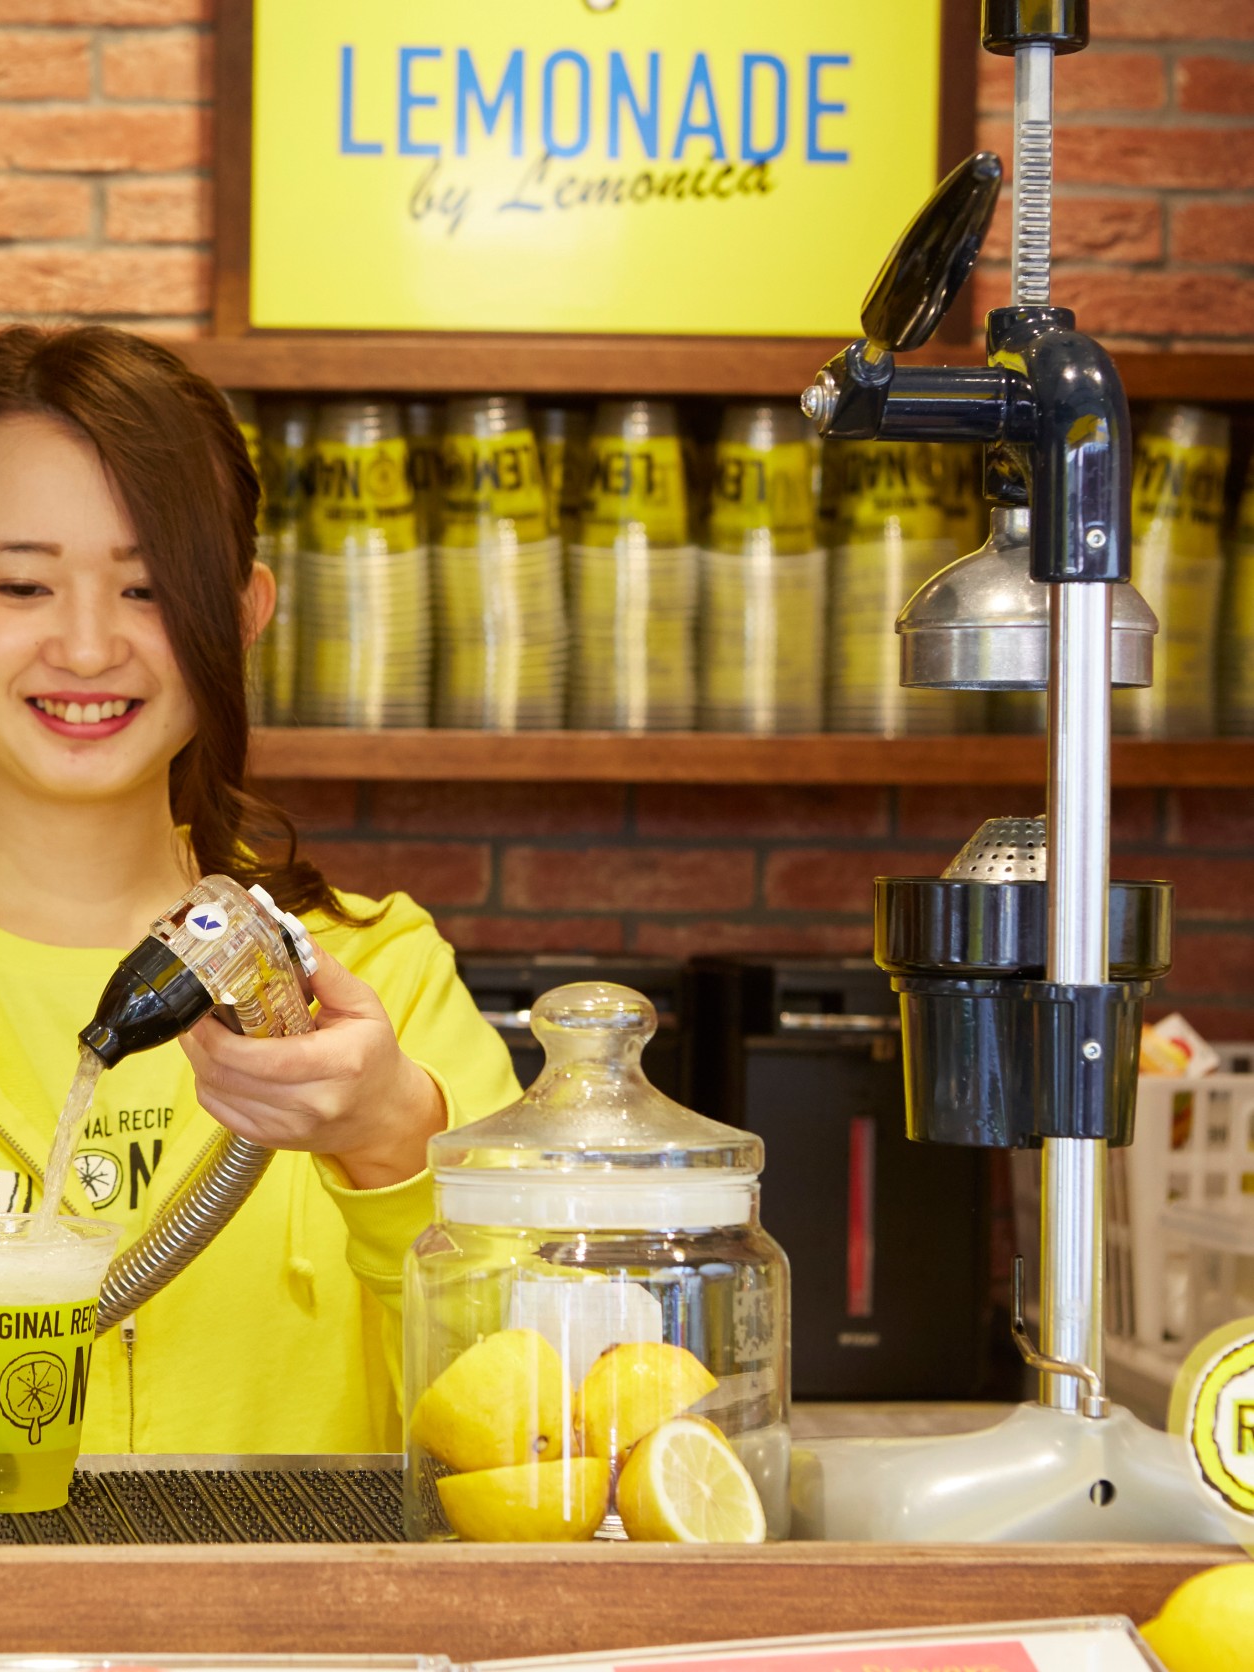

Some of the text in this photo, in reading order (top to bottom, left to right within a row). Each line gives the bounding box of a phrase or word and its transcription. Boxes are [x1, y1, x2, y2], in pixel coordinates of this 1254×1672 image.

[339, 45, 851, 163] LEMONADE
[409, 152, 776, 234] by Lemonica
[70, 1304, 96, 1336] REC
